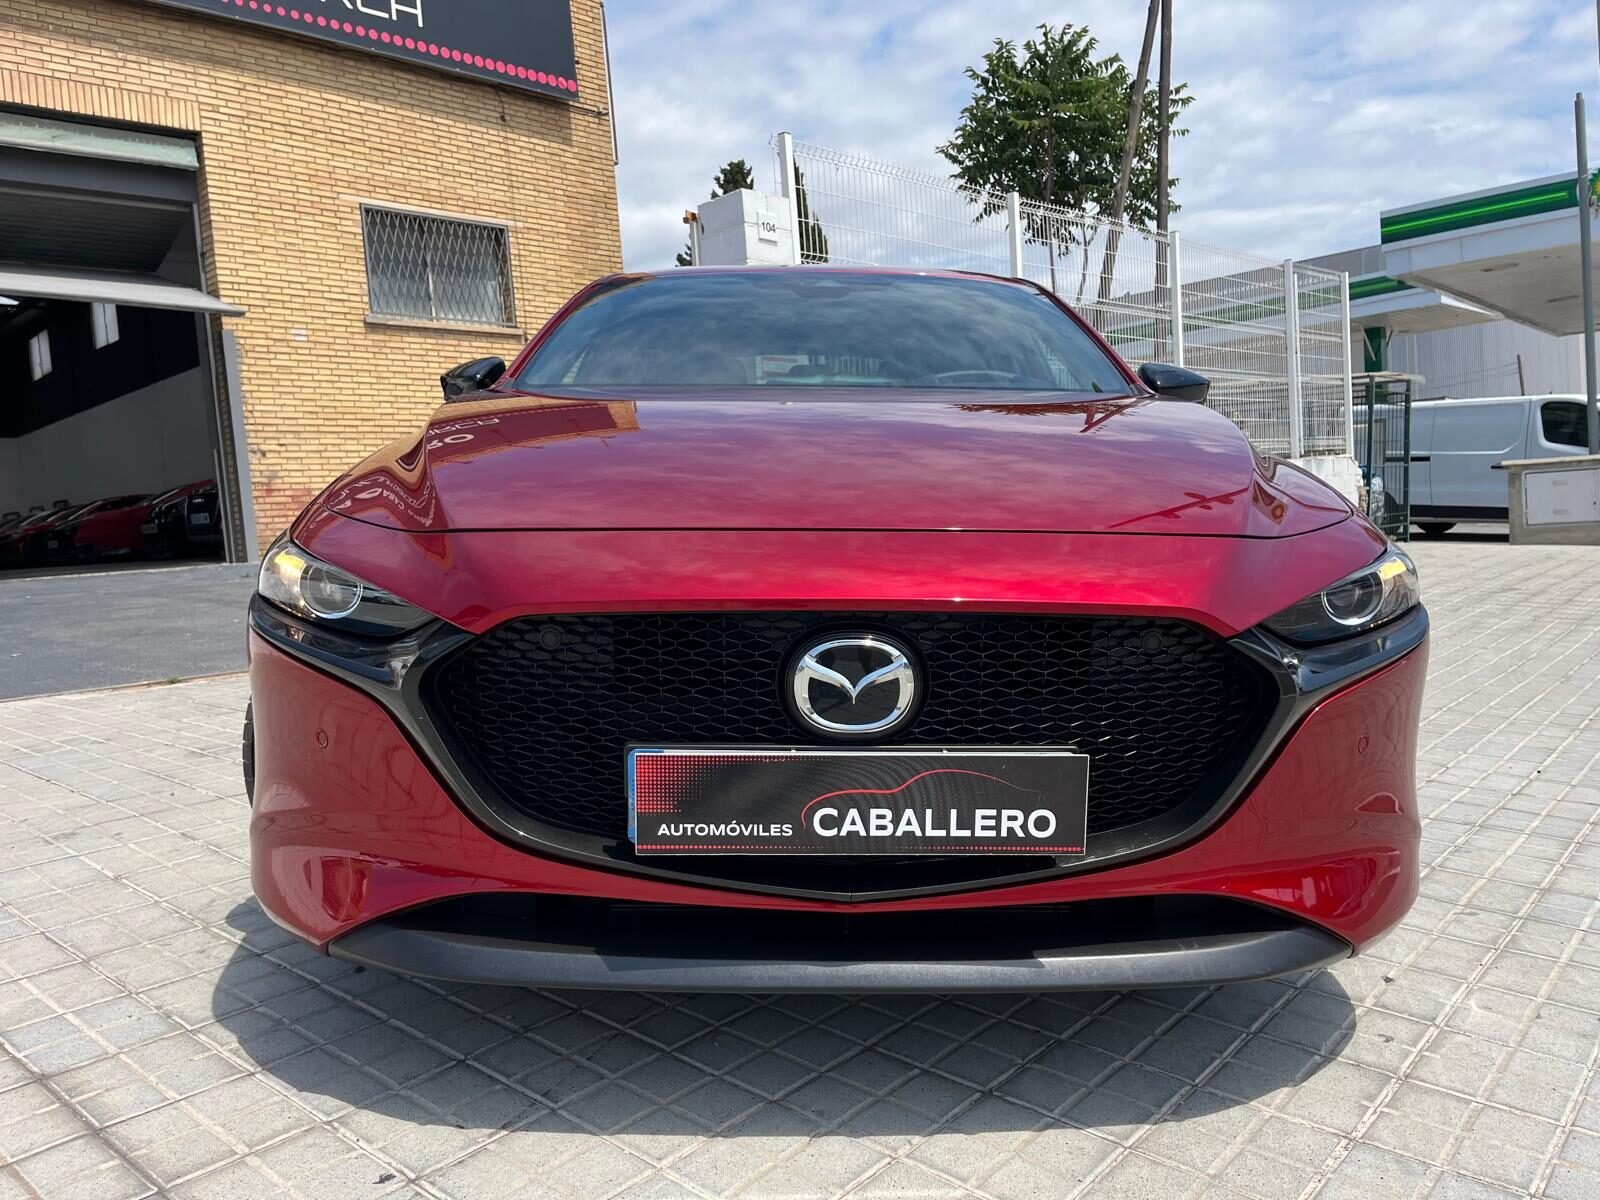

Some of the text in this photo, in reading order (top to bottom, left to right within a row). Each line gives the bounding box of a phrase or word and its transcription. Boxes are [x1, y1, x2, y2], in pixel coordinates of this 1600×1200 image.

[761, 221, 777, 233] 104
[657, 807, 1057, 838] AUTOMÓVILES CABALLERO
